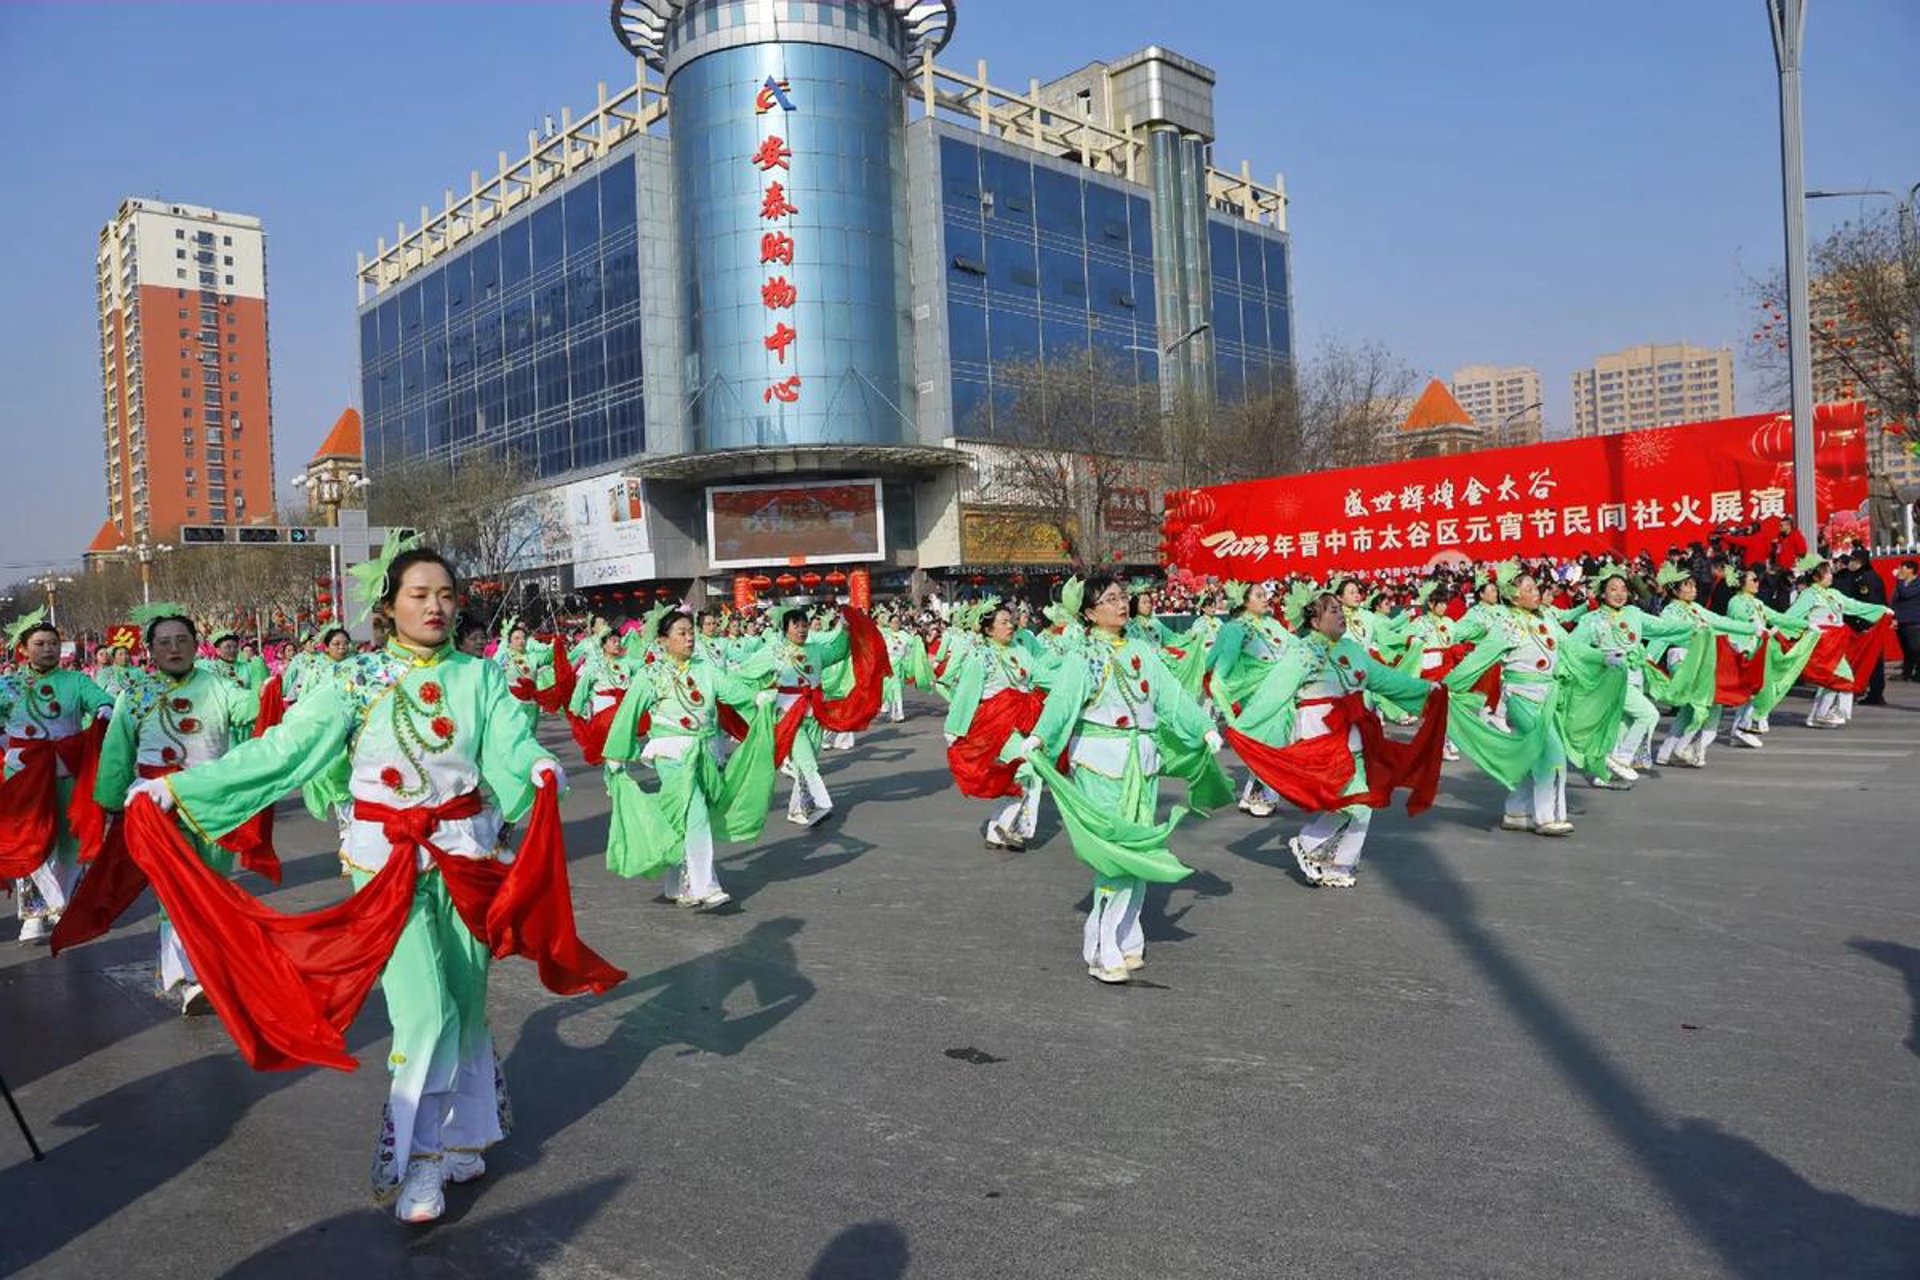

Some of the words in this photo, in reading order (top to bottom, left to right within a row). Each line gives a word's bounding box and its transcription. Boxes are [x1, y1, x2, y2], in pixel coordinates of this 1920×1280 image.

[751, 134, 802, 405] 安泰购物中心
[1201, 486, 1787, 563] 2023年晋中市太谷区元宵节民间社火展演
[1344, 467, 1558, 518] 盛世辉煌金太谷
